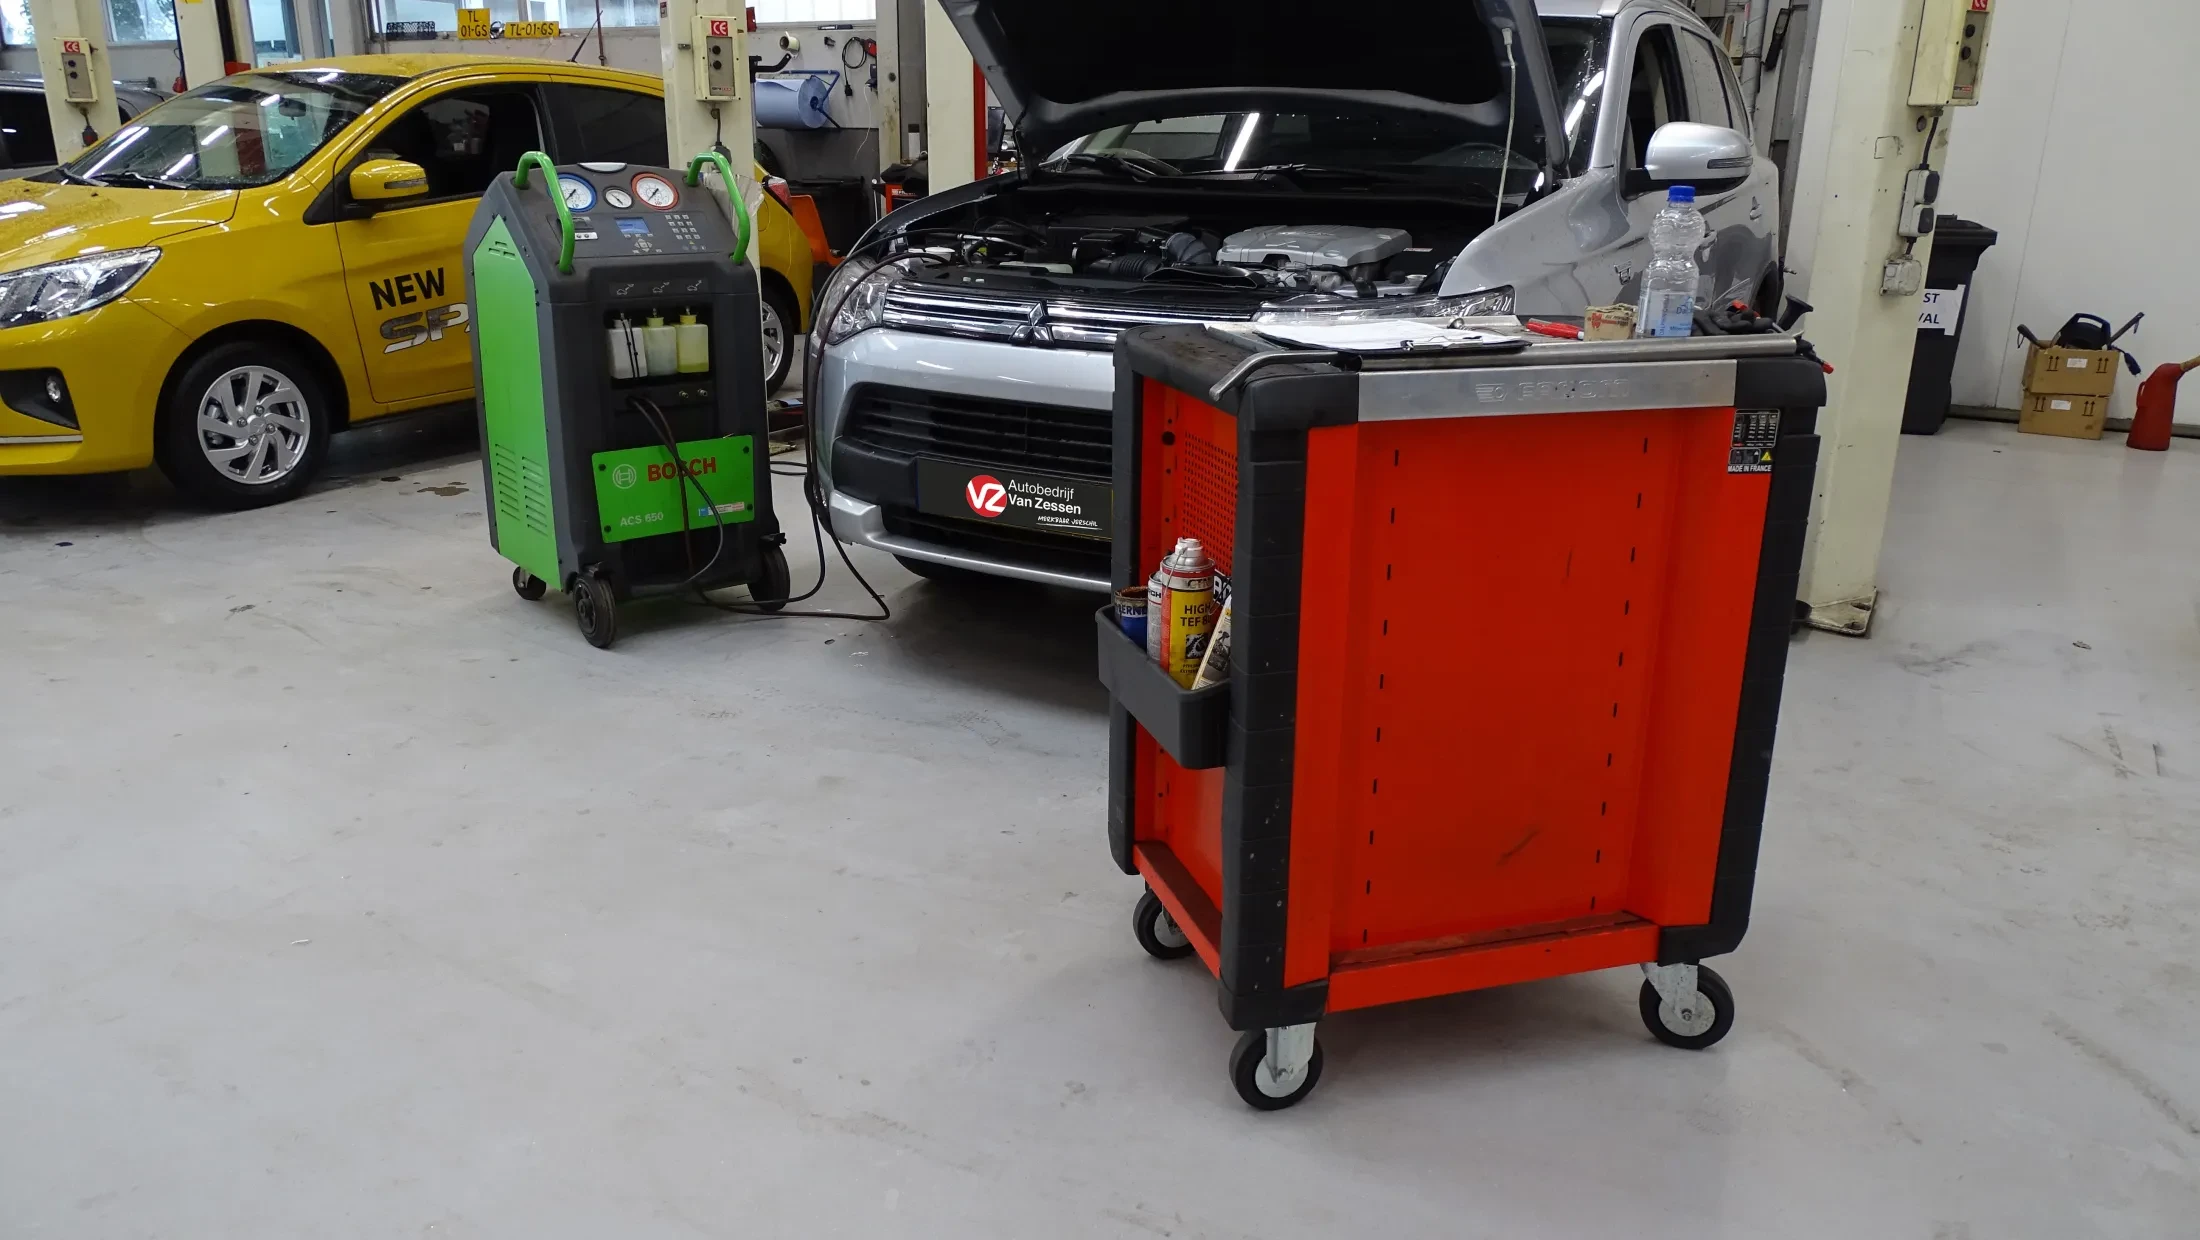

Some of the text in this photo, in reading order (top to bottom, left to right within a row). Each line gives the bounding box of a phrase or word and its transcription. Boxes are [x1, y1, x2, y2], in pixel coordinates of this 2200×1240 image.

[467, 10, 479, 22] TL
[460, 24, 488, 37] 01-GS
[510, 22, 554, 36] TL-01-GS
[369, 267, 445, 311] NEW
[380, 302, 470, 354] SP
[1750, 464, 1772, 472] FRANCE
[967, 481, 1007, 513] VZ
[1008, 479, 1074, 501] Autobedrijf
[1008, 493, 1081, 515] Van Zessen
[620, 512, 664, 527] ACS 650
[1184, 603, 1211, 614] HIGH
[1180, 616, 1201, 627] TEF
